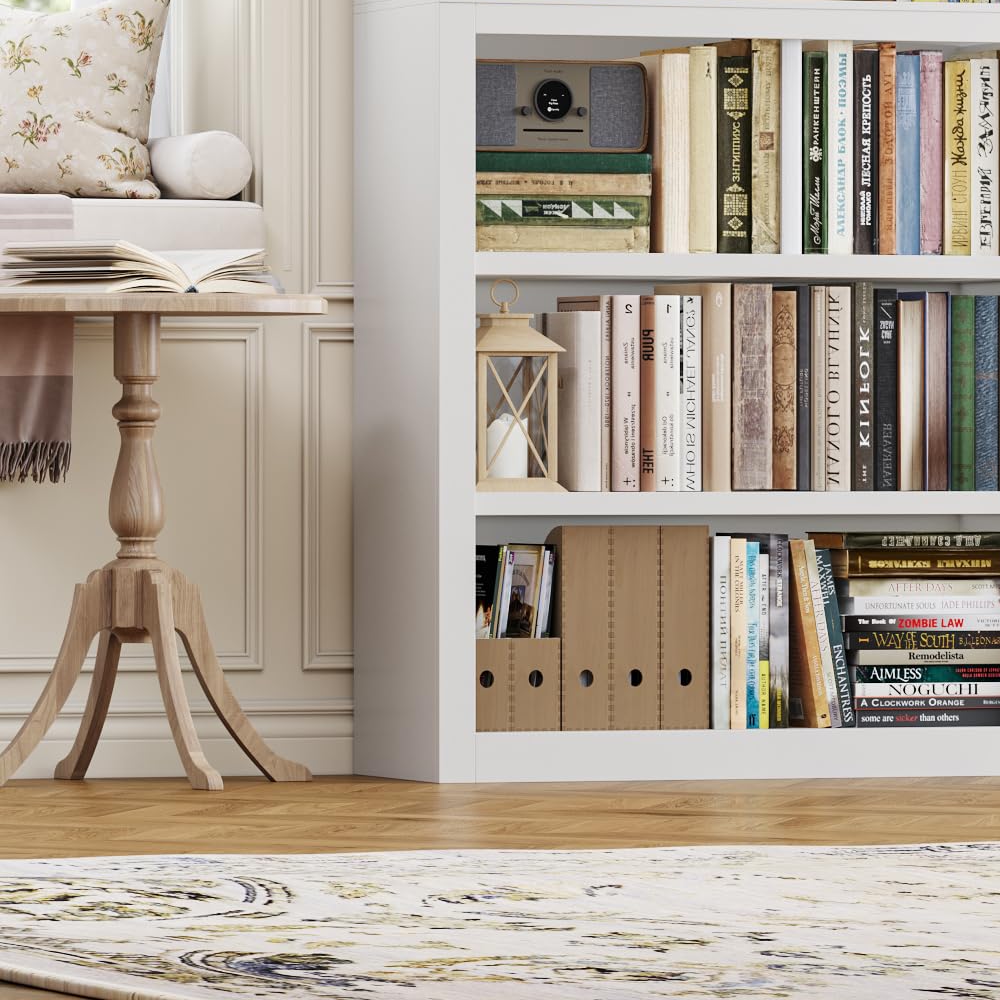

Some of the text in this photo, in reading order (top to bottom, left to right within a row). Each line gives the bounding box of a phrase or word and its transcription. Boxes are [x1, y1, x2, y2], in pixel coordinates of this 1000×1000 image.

[861, 74, 872, 187] ЛЕСНАЯ КРЕПОСТЬ
[836, 53, 847, 236] АЛЕКСАНДР БЛОК ПОЭМЫ
[816, 555, 830, 607] MAXWELL
[824, 564, 835, 597] JAMES
[865, 601, 995, 610] UNFORTUNATE SOULS JADE PHILLIPS
[898, 618, 939, 628] ZOMBIE
[941, 618, 964, 628] LAW
[719, 576, 728, 688] ПОНТИЙ ПИЛАТ
[872, 634, 903, 648] WAY
[920, 633, 955, 649] SOUTH
[908, 652, 964, 661] Remodelista
[869, 666, 922, 683] AIMLESS
[832, 644, 854, 724] ENCHANTRESS
[888, 684, 978, 696] NOGUCHI
[860, 698, 964, 707] A CLOCKWORK ORANGE
[895, 713, 918, 722] sicker
[919, 713, 936, 722] than
[937, 713, 959, 721] others
